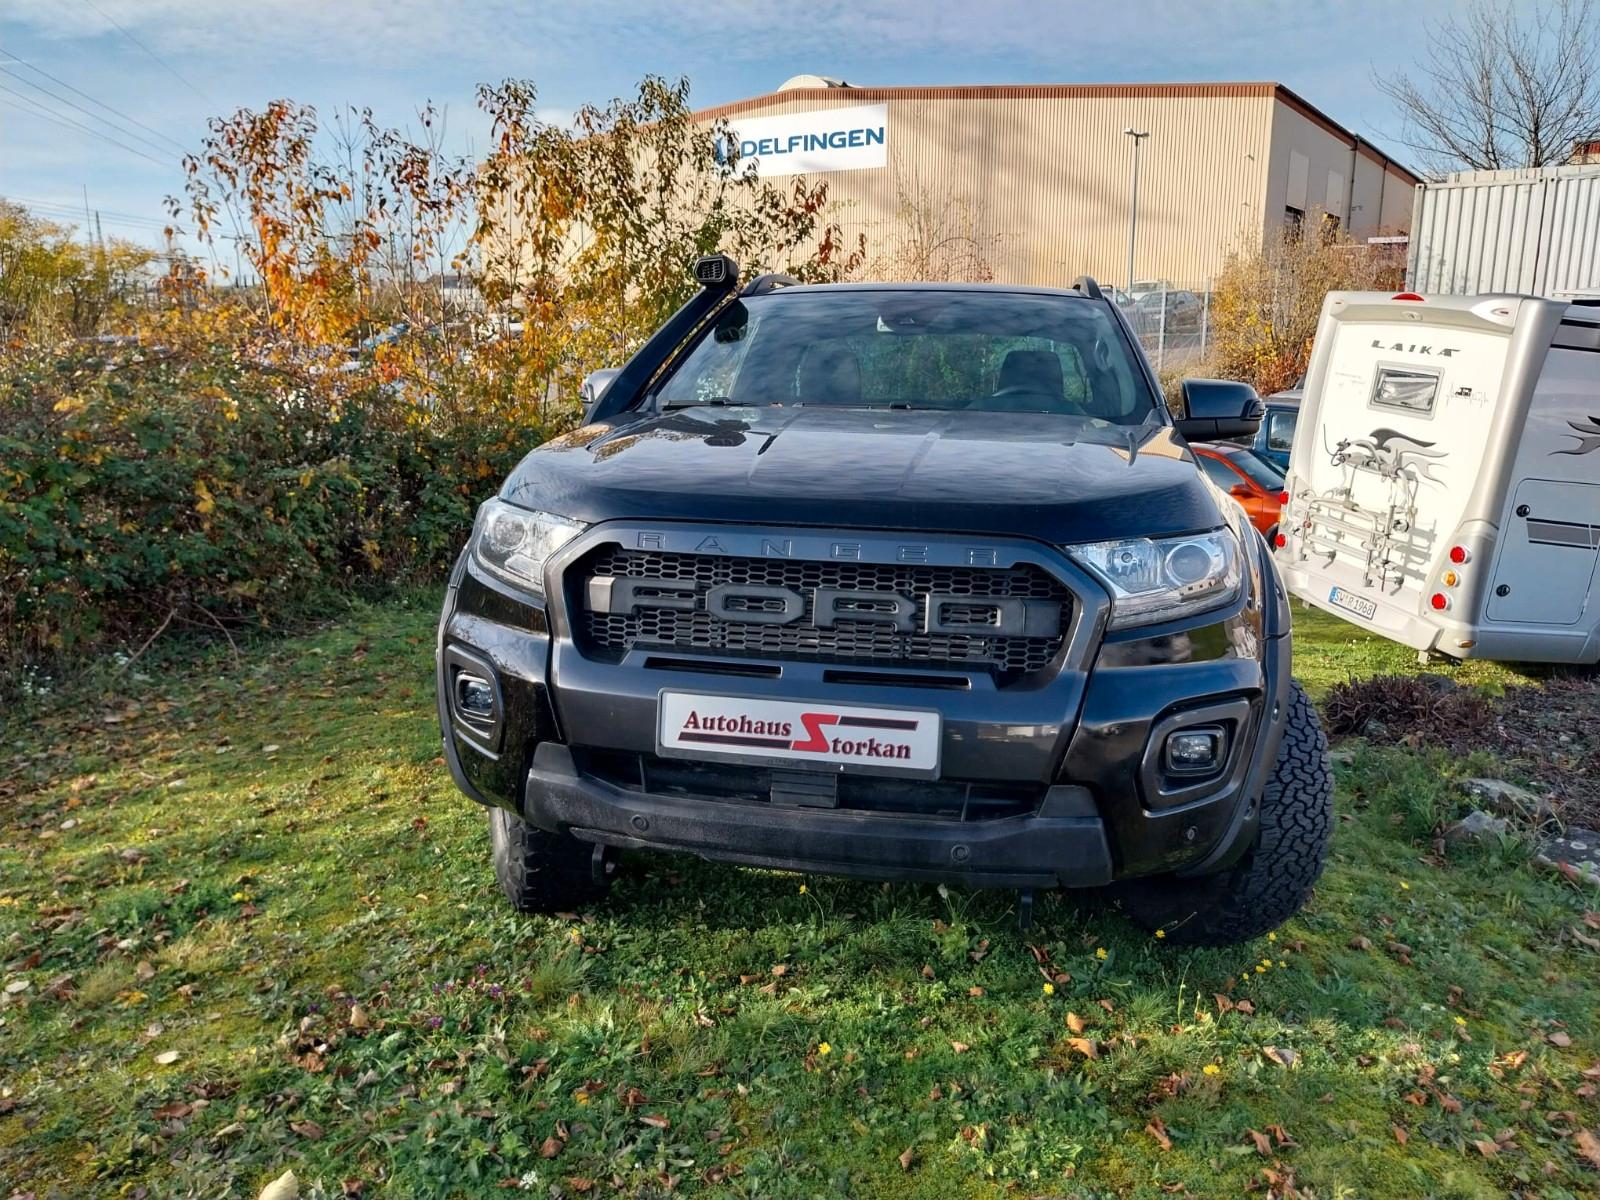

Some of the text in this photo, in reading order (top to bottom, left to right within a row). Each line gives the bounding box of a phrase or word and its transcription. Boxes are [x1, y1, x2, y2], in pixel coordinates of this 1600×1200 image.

[740, 126, 885, 158] DELFINGEN
[1371, 339, 1461, 357] LAIKA
[637, 531, 998, 565] RANGER
[586, 576, 1062, 637] FORD
[683, 710, 911, 759] Autohaus Storkan
